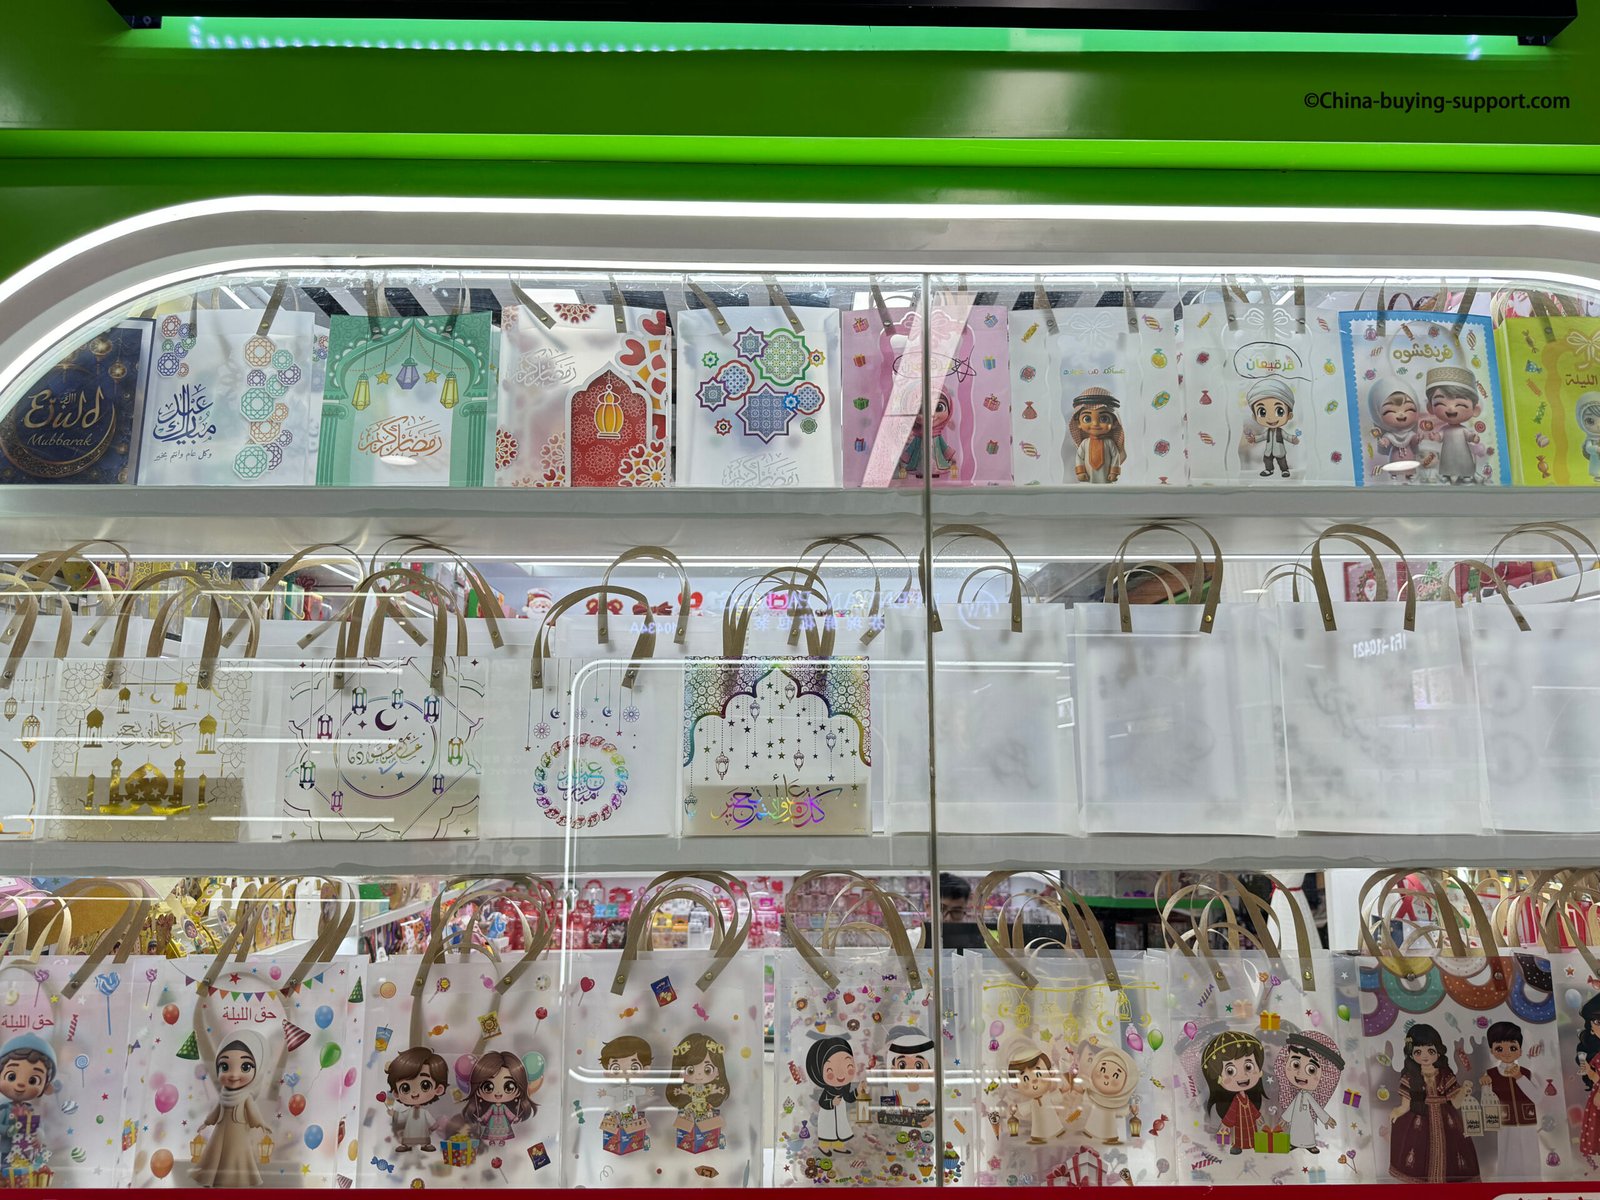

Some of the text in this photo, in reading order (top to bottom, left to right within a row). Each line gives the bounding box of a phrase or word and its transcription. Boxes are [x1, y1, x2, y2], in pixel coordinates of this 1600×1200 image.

[27, 433, 94, 446] Mubbarak
[1, 1014, 54, 1032] حق الليلة
[222, 1006, 277, 1025] حق الليلة
